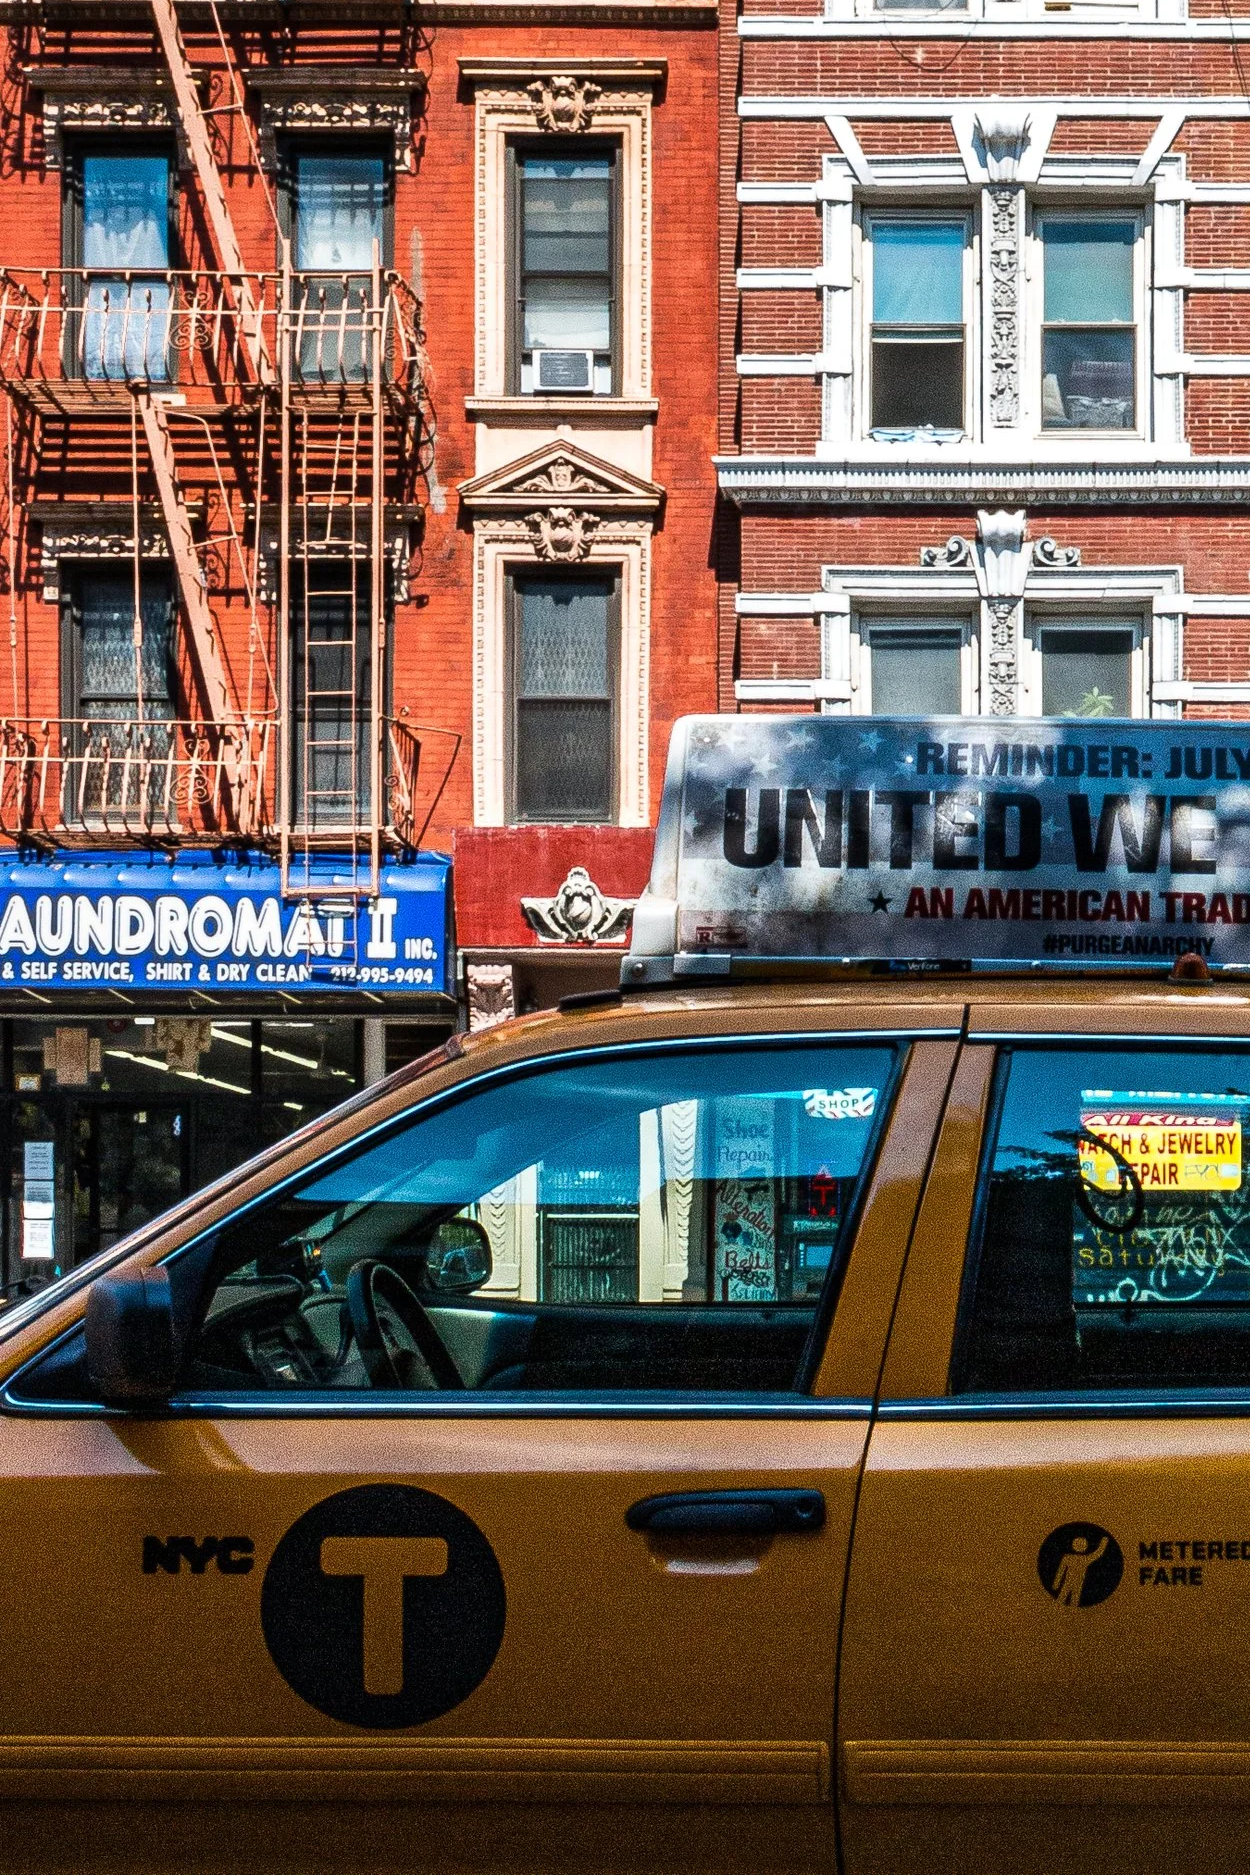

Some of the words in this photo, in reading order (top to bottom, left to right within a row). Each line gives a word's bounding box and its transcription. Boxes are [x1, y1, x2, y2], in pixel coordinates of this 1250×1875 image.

[917, 741, 1152, 779] REMINDER:
[722, 787, 1041, 871] UNITED
[1068, 793, 1217, 876] WE
[904, 887, 953, 919] AN
[963, 887, 1150, 923] AMERICAN
[367, 897, 398, 959] II
[405, 938, 438, 960] INC.
[1043, 933, 1215, 957] #PURGEANARCHY
[3, 962, 15, 980] &
[21, 962, 57, 981] SELF
[63, 961, 134, 983] SERVICE,
[146, 962, 193, 981] SHIRT
[198, 963, 211, 982] &
[216, 963, 251, 982] DRY
[331, 966, 434, 984] 212-995-9494
[818, 1098, 860, 1110] SHOP
[1139, 1133, 1150, 1154] &
[1157, 1132, 1237, 1155] JEWELRY
[1118, 1162, 1179, 1185] PAIR
[1138, 1566, 1204, 1587] FARE
[142, 1535, 255, 1575] NYC
[319, 1536, 449, 1696] T
